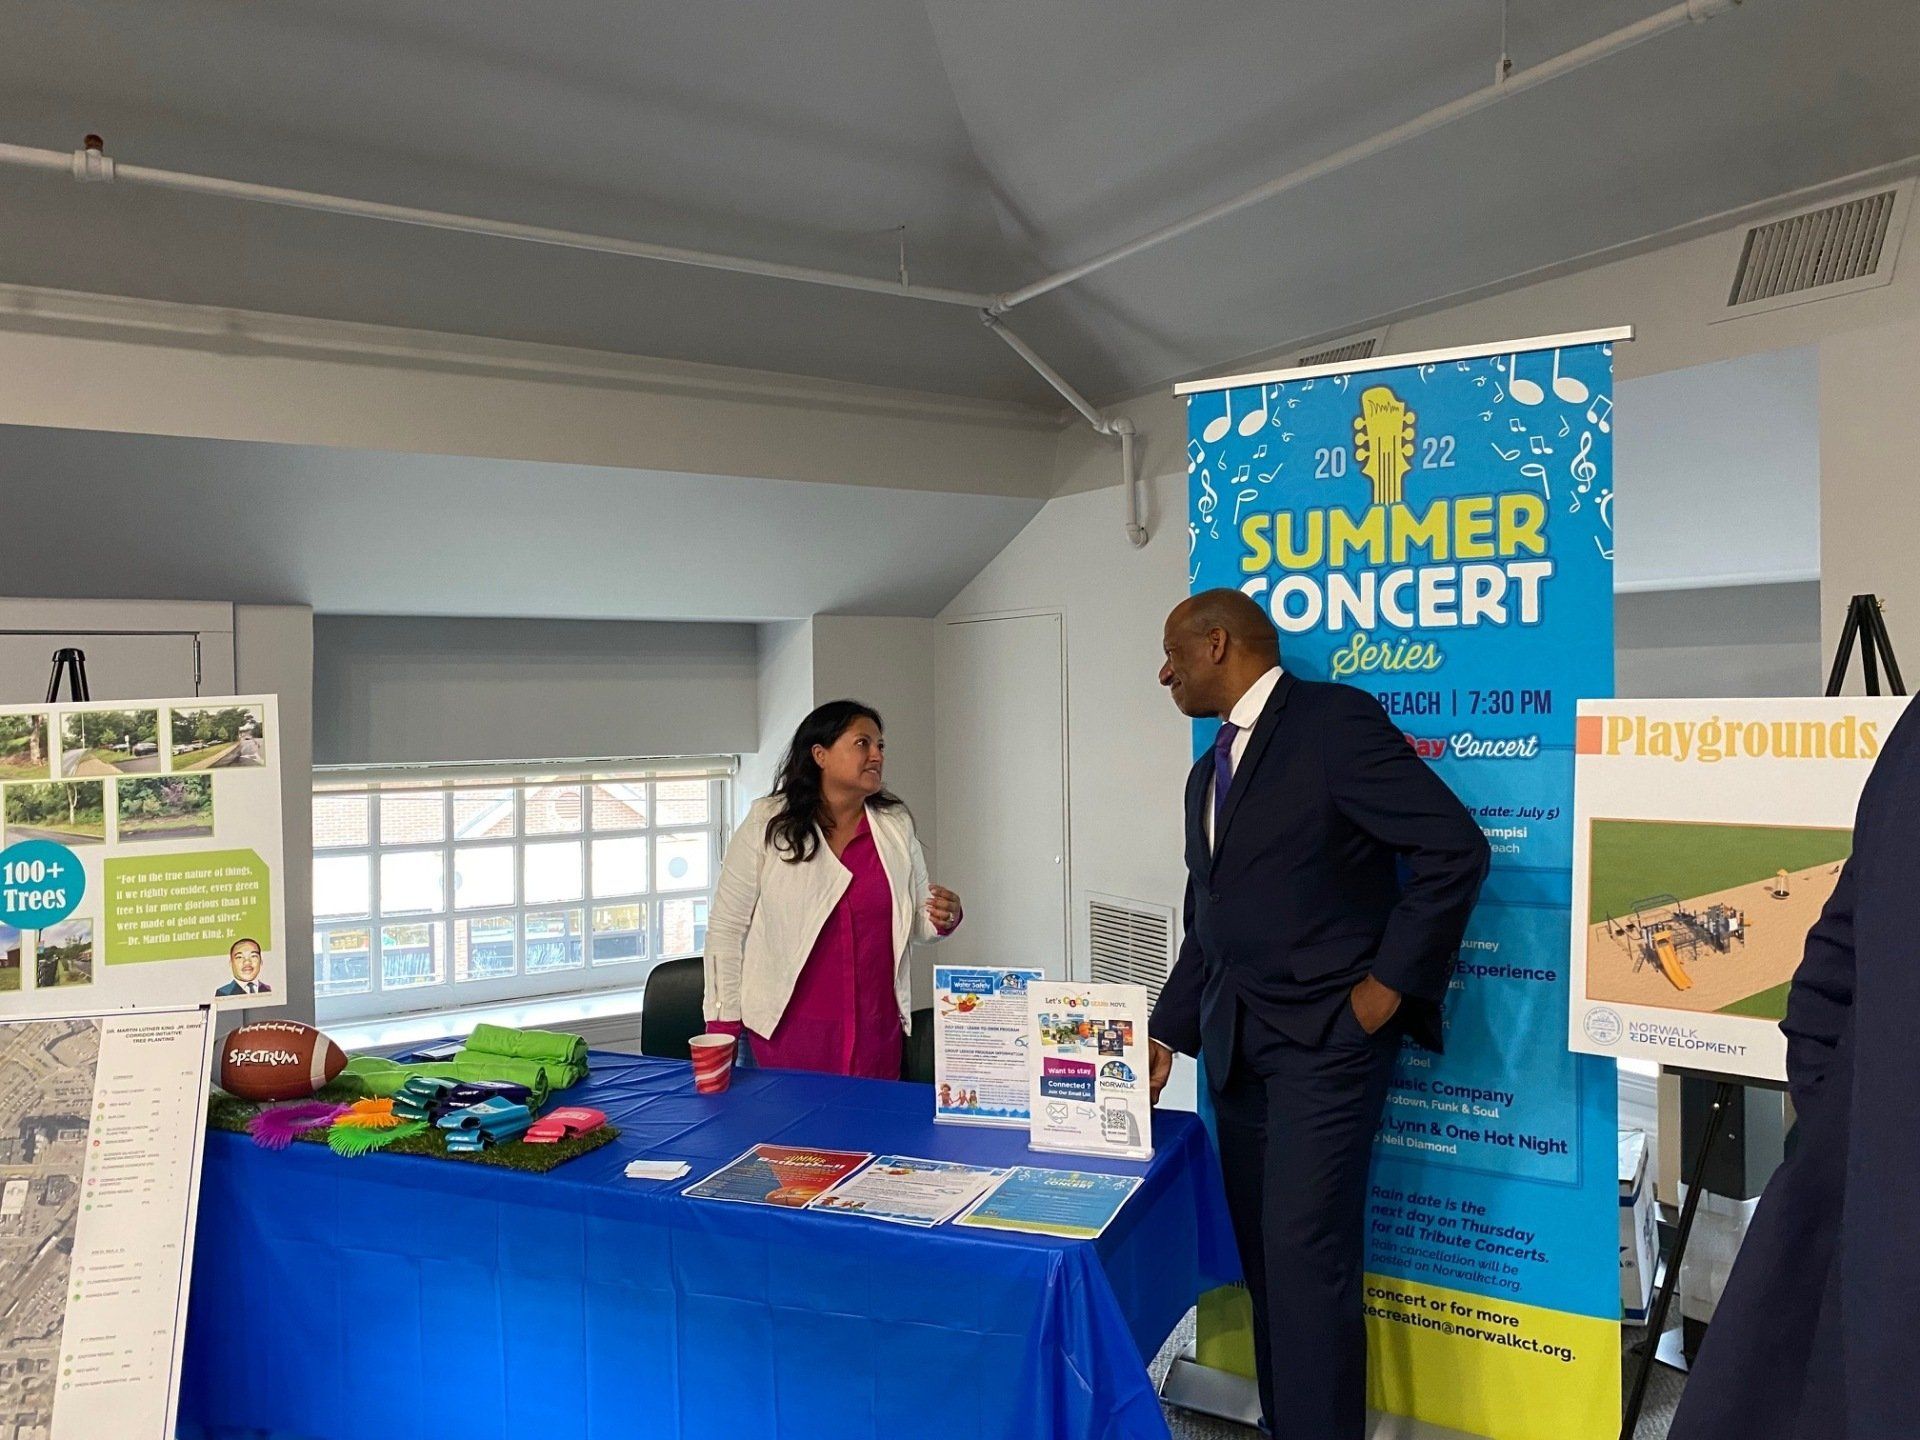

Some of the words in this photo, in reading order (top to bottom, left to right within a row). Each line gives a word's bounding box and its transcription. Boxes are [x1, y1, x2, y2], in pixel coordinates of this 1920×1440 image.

[1314, 446, 1347, 480] 20
[1422, 436, 1456, 469] 22
[1240, 493, 1546, 572] SUMMER
[1332, 632, 1442, 680] Series
[1377, 691, 1440, 715] BEACH
[1469, 690, 1514, 715] 7:30
[1520, 690, 1551, 714] PM
[1451, 732, 1538, 757] Concert
[1606, 715, 1879, 762] Playgrounds
[1480, 805, 1513, 817] date:
[1515, 807, 1544, 820] July
[1547, 808, 1560, 820] 5)
[1480, 826, 1527, 840] ampisi
[1490, 843, 1520, 854] each
[3, 860, 64, 885] 100+
[138, 874, 147, 882] in
[149, 872, 162, 882] the
[165, 872, 182, 881] true
[185, 869, 212, 879] nature
[214, 868, 223, 877] of
[225, 866, 252, 876] things,
[3, 888, 66, 912] Trees
[116, 891, 123, 900] if
[125, 890, 137, 898] we
[139, 888, 168, 898] rightly
[170, 885, 208, 896] consider,
[210, 883, 232, 893] every
[235, 881, 259, 891] green
[116, 906, 134, 915] tree
[135, 905, 143, 914] is
[145, 904, 158, 913] far
[160, 902, 182, 912] more
[184, 899, 219, 911] glorious
[221, 898, 240, 907] than
[242, 897, 248, 905] if
[250, 896, 256, 904] it
[117, 921, 138, 931] were
[140, 919, 164, 929] made
[167, 918, 176, 927] of
[178, 916, 196, 927] gold
[199, 915, 214, 924] and
[143, 934, 171, 944] Martin
[173, 931, 199, 942] Luther
[1461, 940, 1499, 952] ourney
[1455, 960, 1557, 981] Experience
[1045, 997, 1062, 1005] Let's
[1629, 1022, 1698, 1039] NORWALK
[229, 1049, 299, 1066] SPECTRUM
[1408, 1056, 1430, 1068] Joel
[1048, 1081, 1085, 1089] Connected
[1100, 1080, 1135, 1089] NORWALK
[1391, 1078, 1427, 1092] usic
[1431, 1081, 1514, 1107] Company
[1431, 1100, 1459, 1112] Funk
[1462, 1104, 1470, 1114] &
[1473, 1105, 1499, 1119] Soul
[1382, 1133, 1404, 1146] Neil
[1407, 1137, 1456, 1154] Diamond
[1389, 1116, 1426, 1133] Lynn
[1430, 1122, 1441, 1136] &
[1446, 1124, 1480, 1142] One
[1484, 1129, 1515, 1147] Hot
[1519, 1135, 1568, 1156] Night
[1371, 1186, 1403, 1200] Rain
[1407, 1192, 1441, 1208] date
[1445, 1197, 1457, 1211] is
[1461, 1200, 1486, 1216] the
[1371, 1204, 1403, 1218] next
[1407, 1209, 1435, 1227] day
[1438, 1217, 1457, 1228] on
[1462, 1217, 1535, 1245] Thursday
[1371, 1220, 1392, 1233] for
[1395, 1224, 1415, 1238] all
[1419, 1227, 1471, 1248] Tribute
[1475, 1239, 1550, 1264] Concerts.
[1371, 1238, 1397, 1251] Rain
[1400, 1245, 1475, 1267] cancellation
[1479, 1258, 1499, 1273] will
[1503, 1264, 1518, 1276] be
[1372, 1253, 1411, 1270] posted
[1415, 1259, 1429, 1270] on
[1432, 1263, 1522, 1293] Norwalkct.org.
[1367, 1286, 1427, 1308] concert
[1430, 1301, 1447, 1312] or
[1450, 1301, 1473, 1317] for
[1477, 1309, 1519, 1327] more
